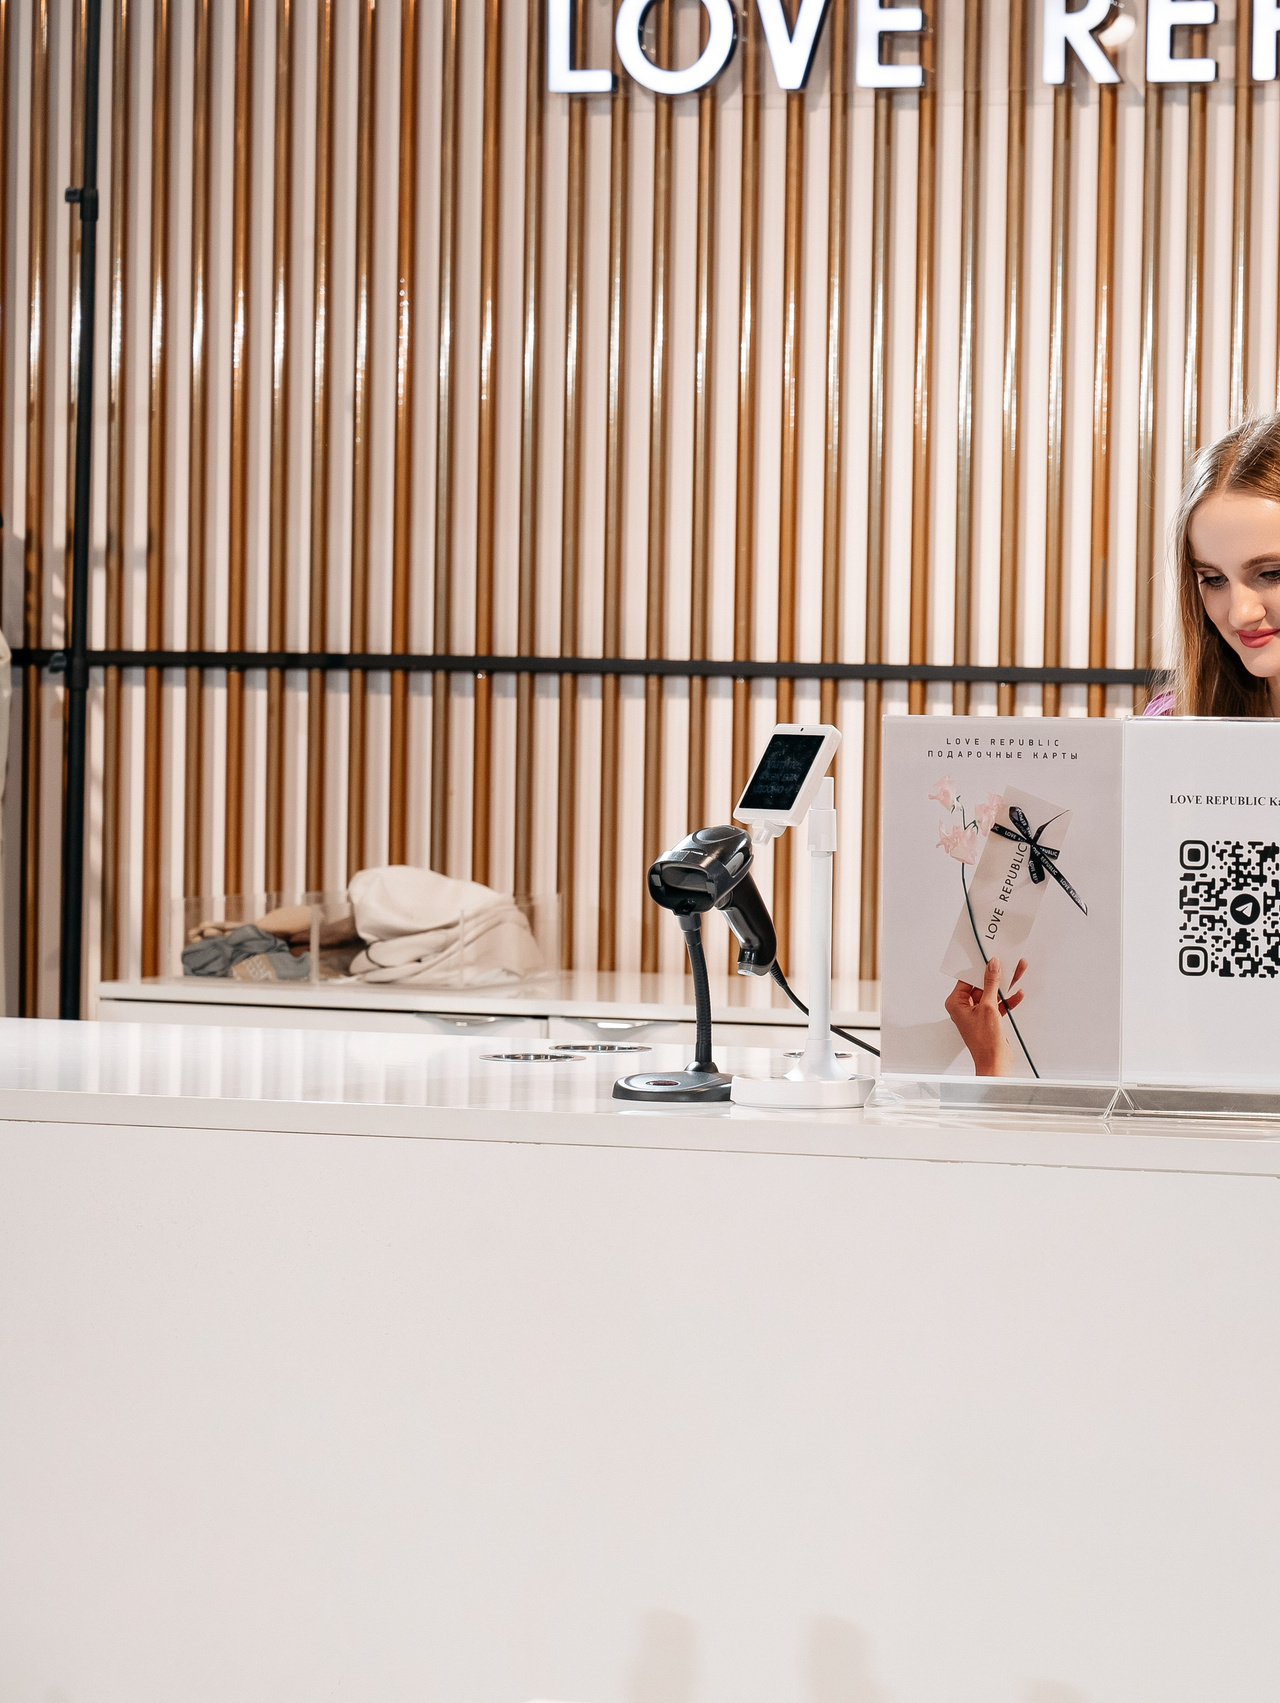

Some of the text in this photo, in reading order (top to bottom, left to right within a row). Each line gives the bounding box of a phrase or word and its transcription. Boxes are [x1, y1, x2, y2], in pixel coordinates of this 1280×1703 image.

[547, 0, 925, 96] LOVE
[946, 737, 1060, 747] LOVE REPUBLIC
[927, 750, 1078, 760] ПОДАРОЧНЫЕ КАРТЫ
[1169, 794, 1203, 805] LOVE
[1205, 795, 1266, 806] REPUBLIC
[985, 907, 1004, 940] LOVE
[999, 843, 1028, 903] REPUBLIC
